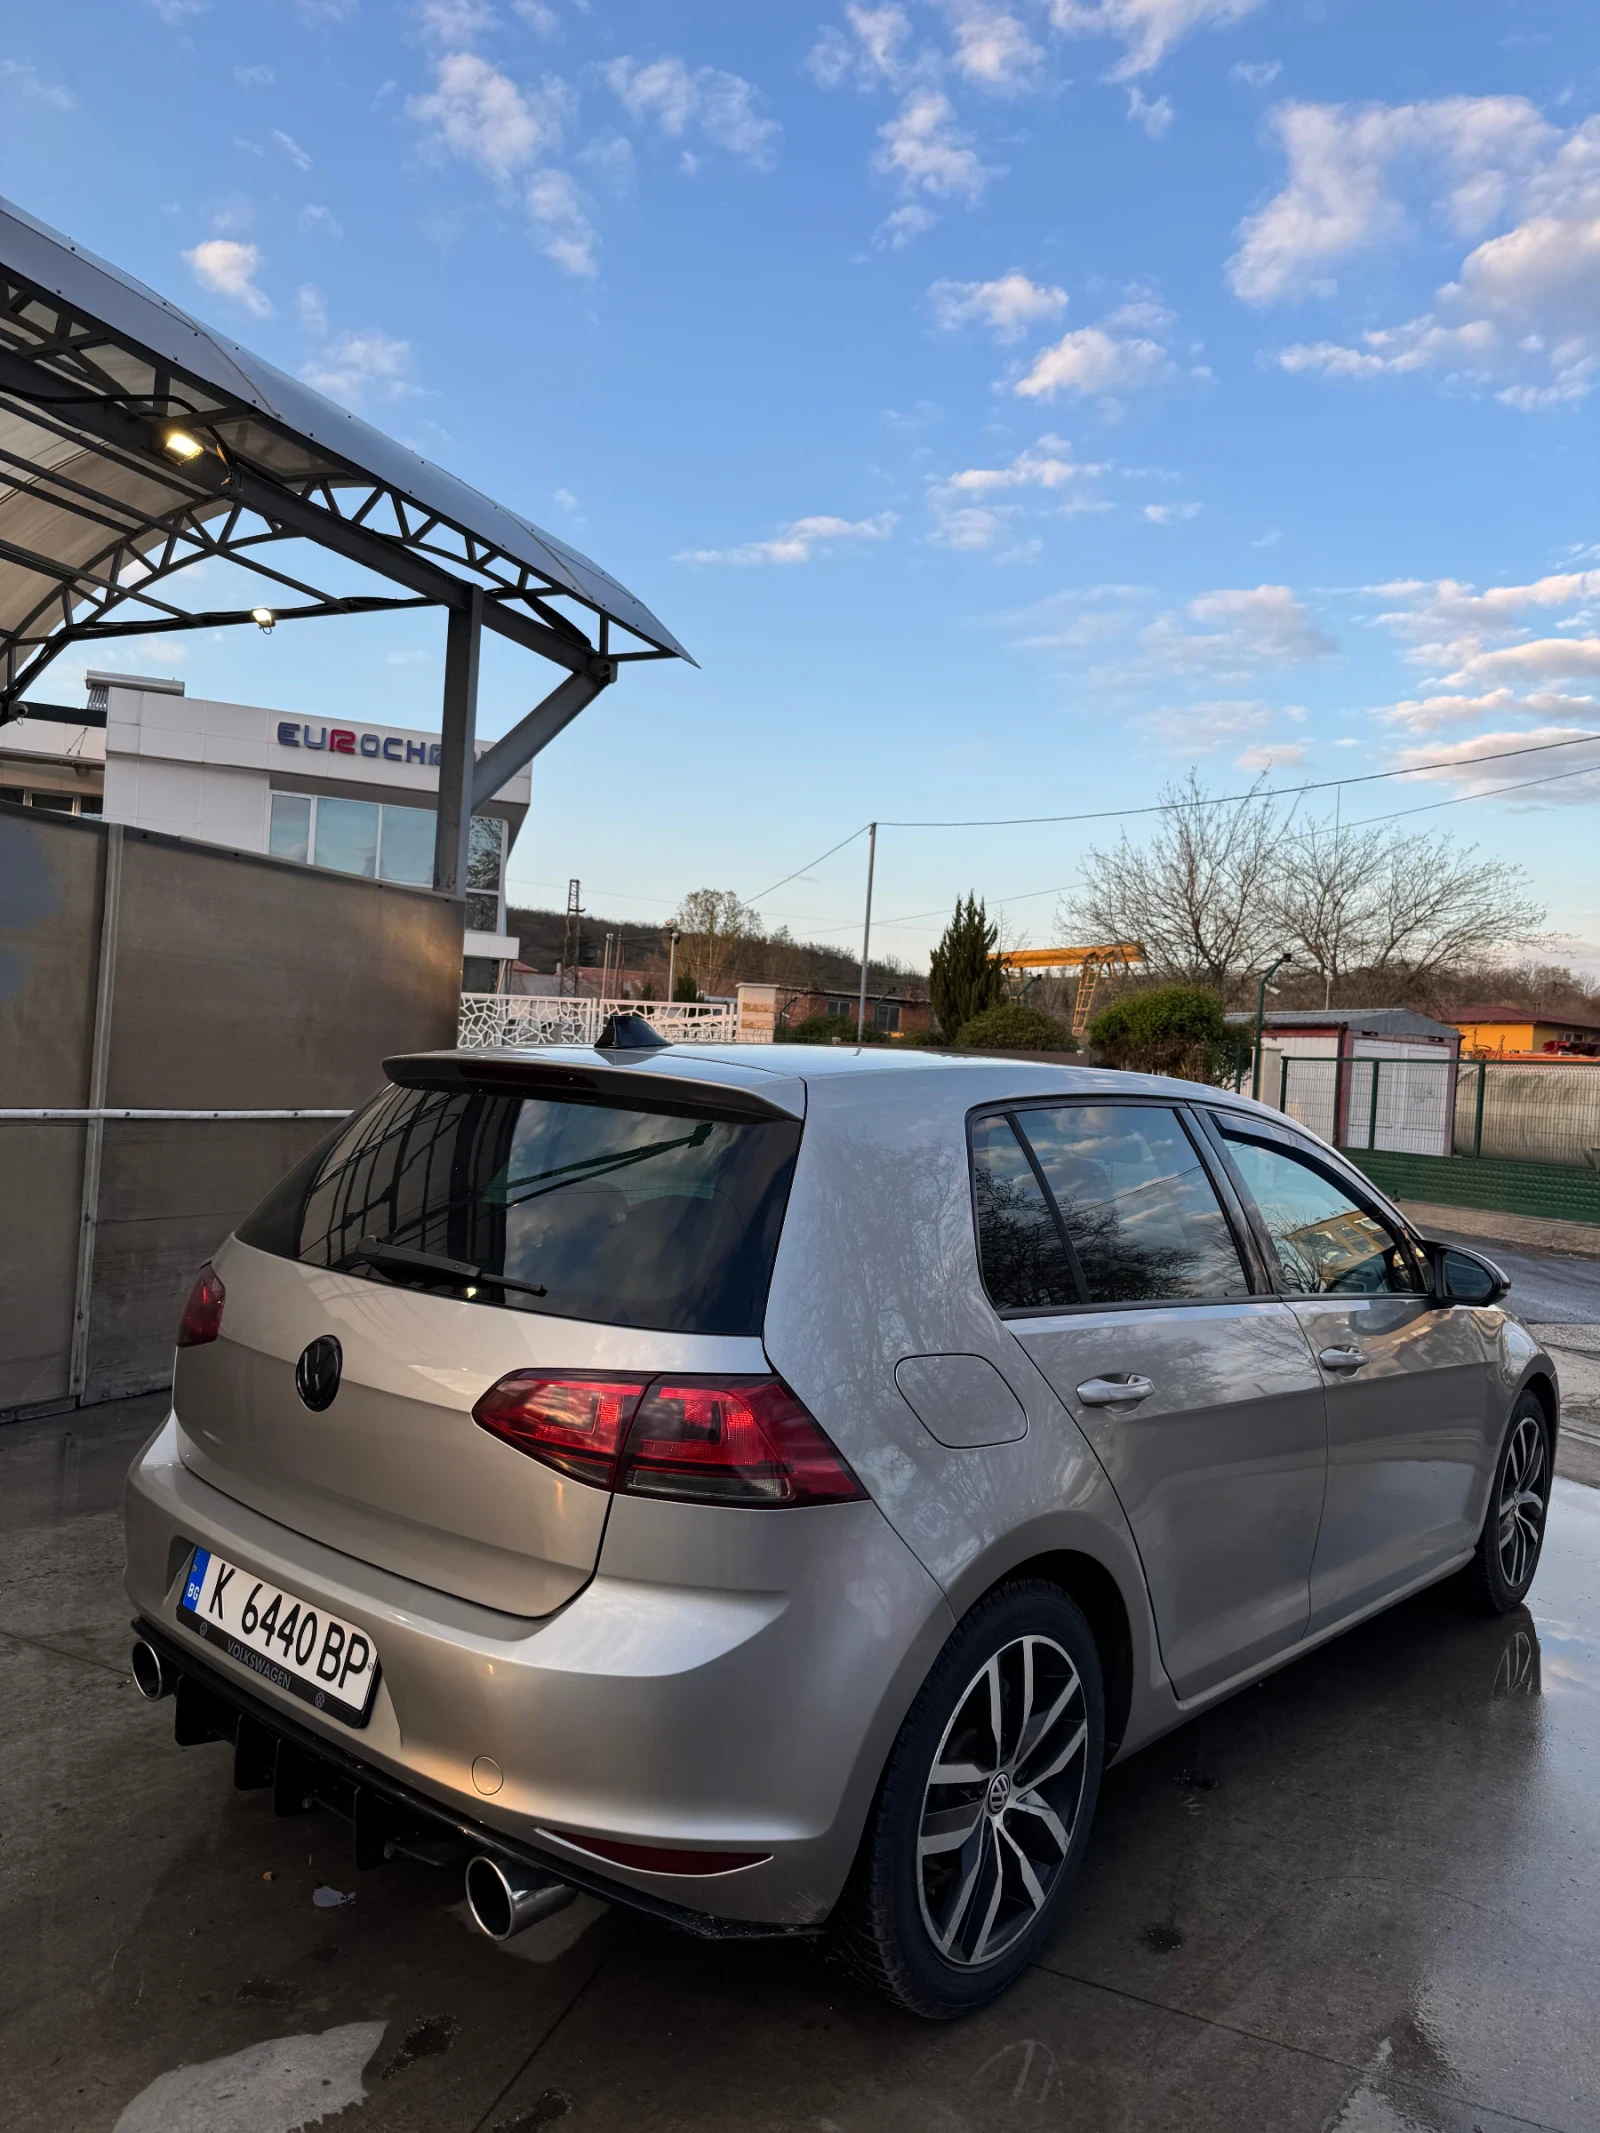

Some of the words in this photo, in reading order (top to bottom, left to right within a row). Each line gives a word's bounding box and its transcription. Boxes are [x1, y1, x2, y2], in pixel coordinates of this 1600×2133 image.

[277, 721, 488, 767] EUROCHR
[187, 1582, 200, 1601] BG
[208, 1562, 236, 1620] K
[241, 1583, 318, 1666] 6440
[316, 1621, 369, 1689] BP
[227, 1639, 291, 1690] VOLKSWAGEN
